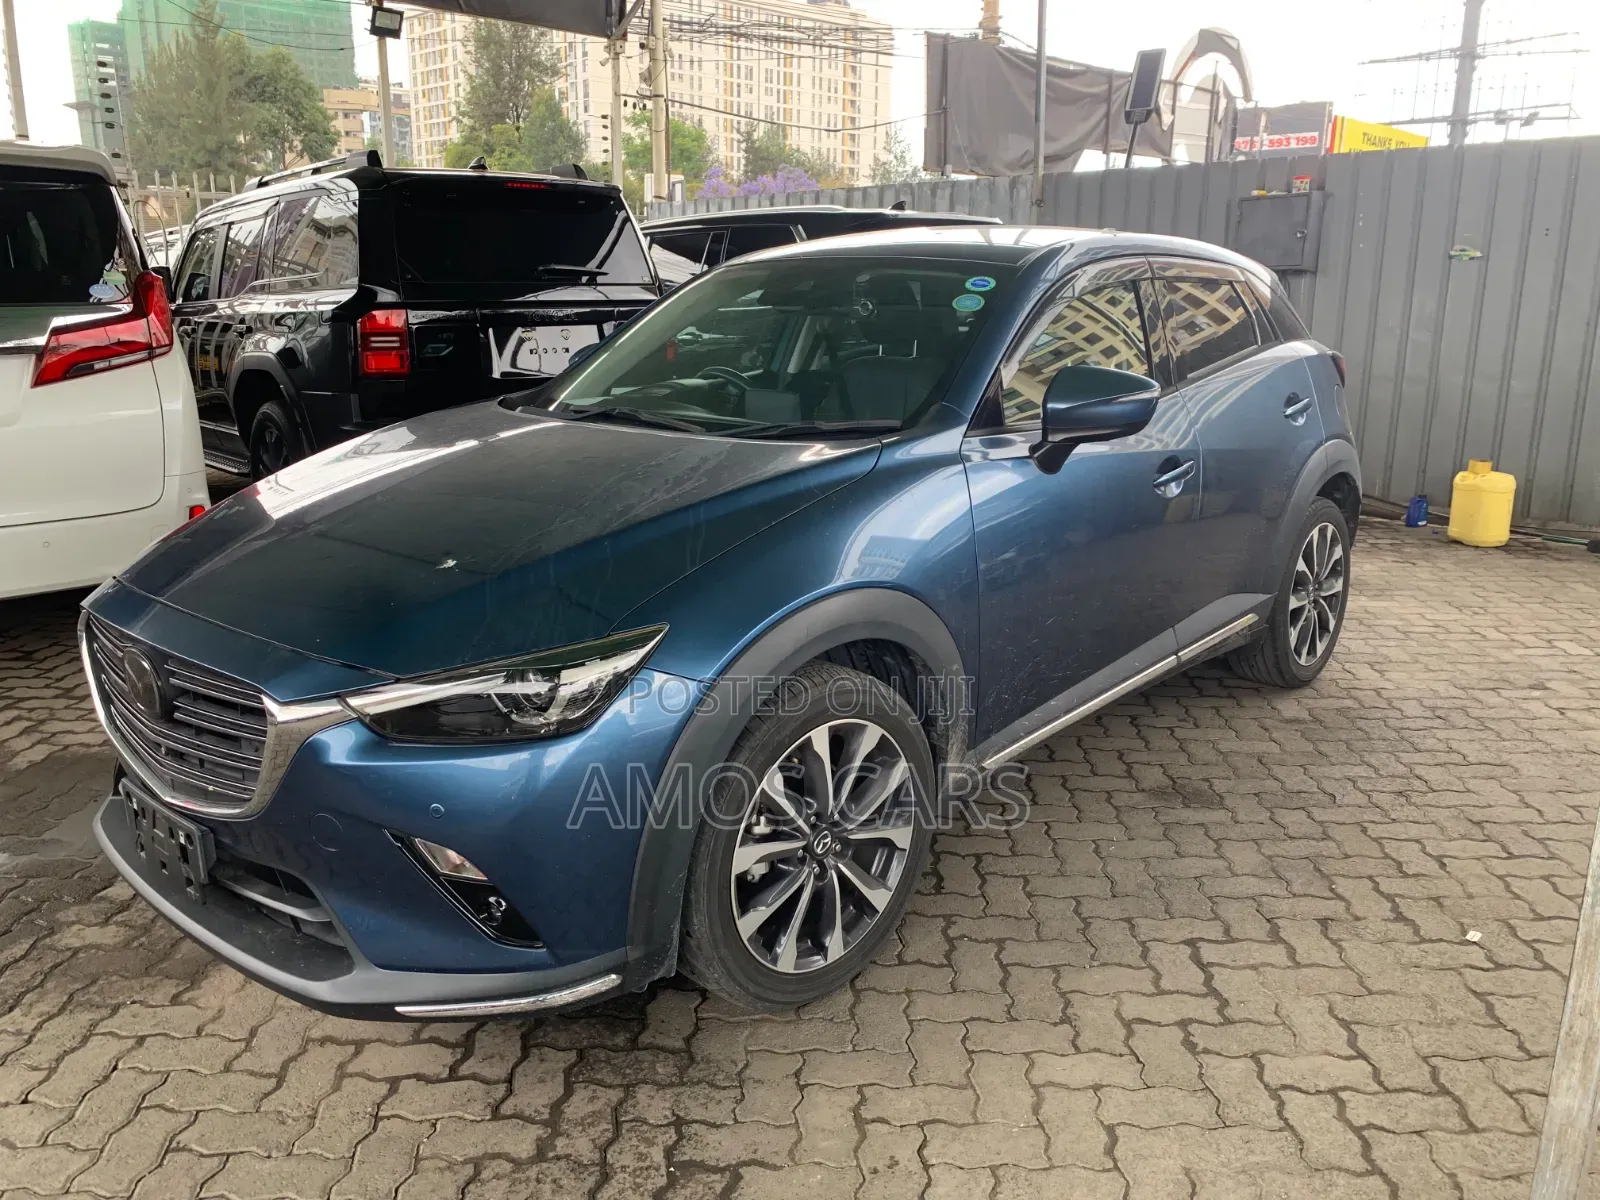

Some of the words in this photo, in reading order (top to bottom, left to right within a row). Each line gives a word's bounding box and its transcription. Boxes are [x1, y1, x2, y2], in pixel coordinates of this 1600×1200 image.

[1267, 136, 1291, 148] 593
[1295, 135, 1317, 146] 199
[1362, 132, 1393, 149] THANKS
[523, 309, 578, 321] TOYOTA
